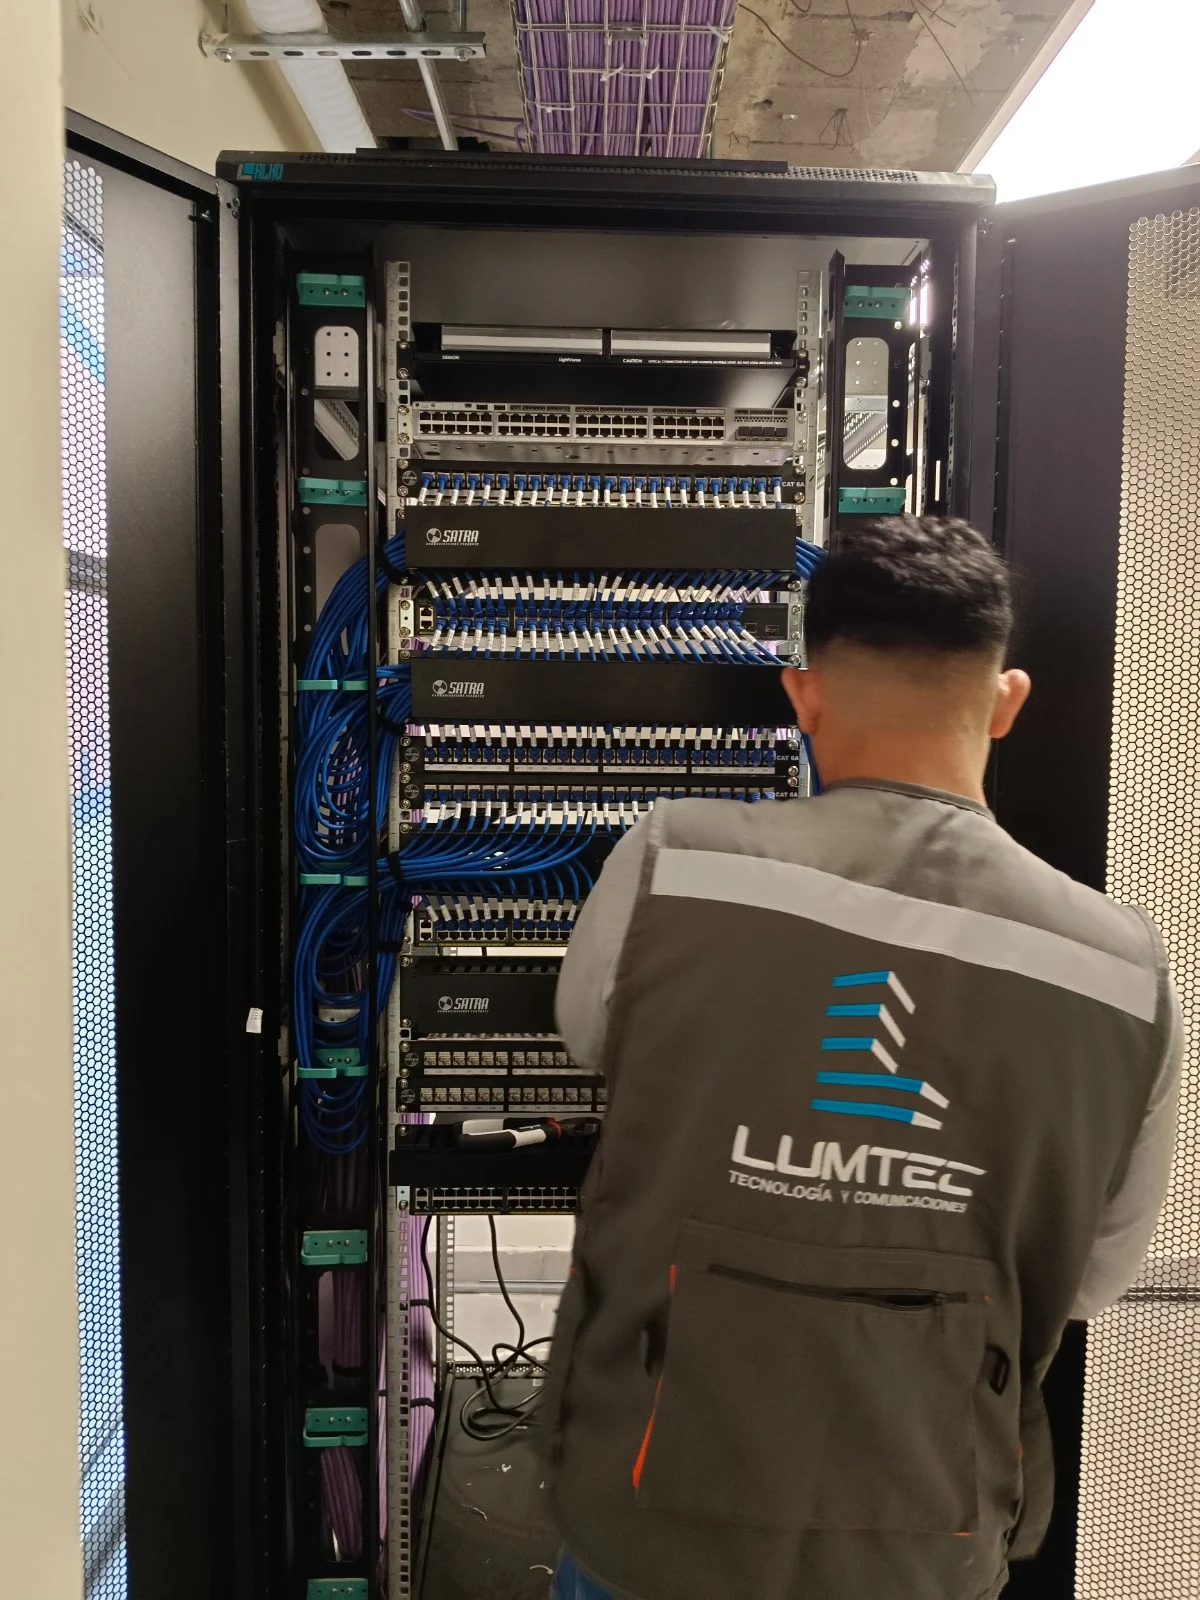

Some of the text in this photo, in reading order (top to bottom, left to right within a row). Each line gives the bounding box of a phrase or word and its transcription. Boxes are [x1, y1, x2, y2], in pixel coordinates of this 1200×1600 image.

[442, 529, 479, 543] SATRA
[448, 681, 485, 695] SATRA
[453, 997, 490, 1010] SATRA
[731, 1124, 987, 1197] LUMTEC
[728, 1170, 968, 1214] TECNOLOGÍA Y COMUNICACIONES
